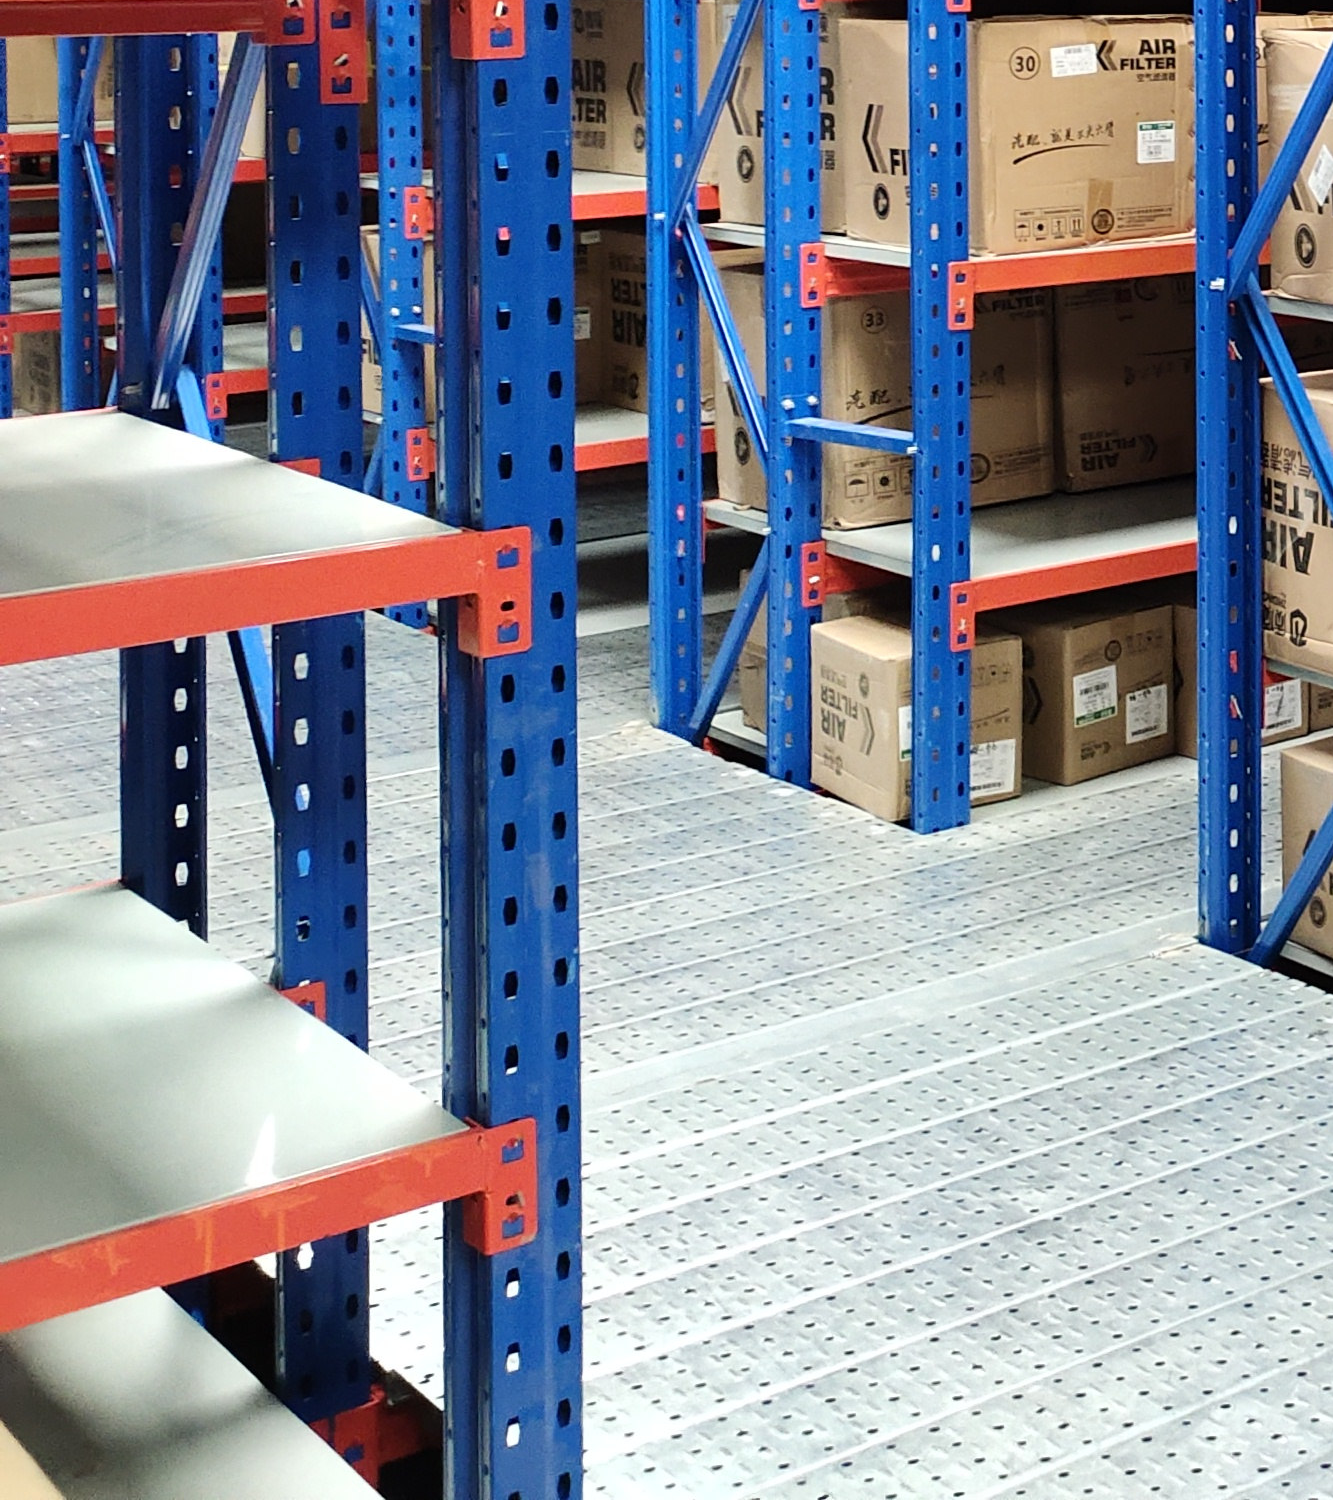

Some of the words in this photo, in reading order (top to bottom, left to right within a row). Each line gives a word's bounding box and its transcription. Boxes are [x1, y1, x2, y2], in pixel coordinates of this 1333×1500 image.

[1138, 39, 1176, 55] AIR
[1014, 56, 1036, 72] 30
[1120, 58, 1176, 71] FILTER
[572, 59, 606, 93] AIR
[992, 295, 1046, 313] FILTER
[866, 313, 884, 327] 33
[1081, 455, 1117, 473] AIR
[821, 685, 858, 720] FILTER
[821, 708, 846, 743] AIR
